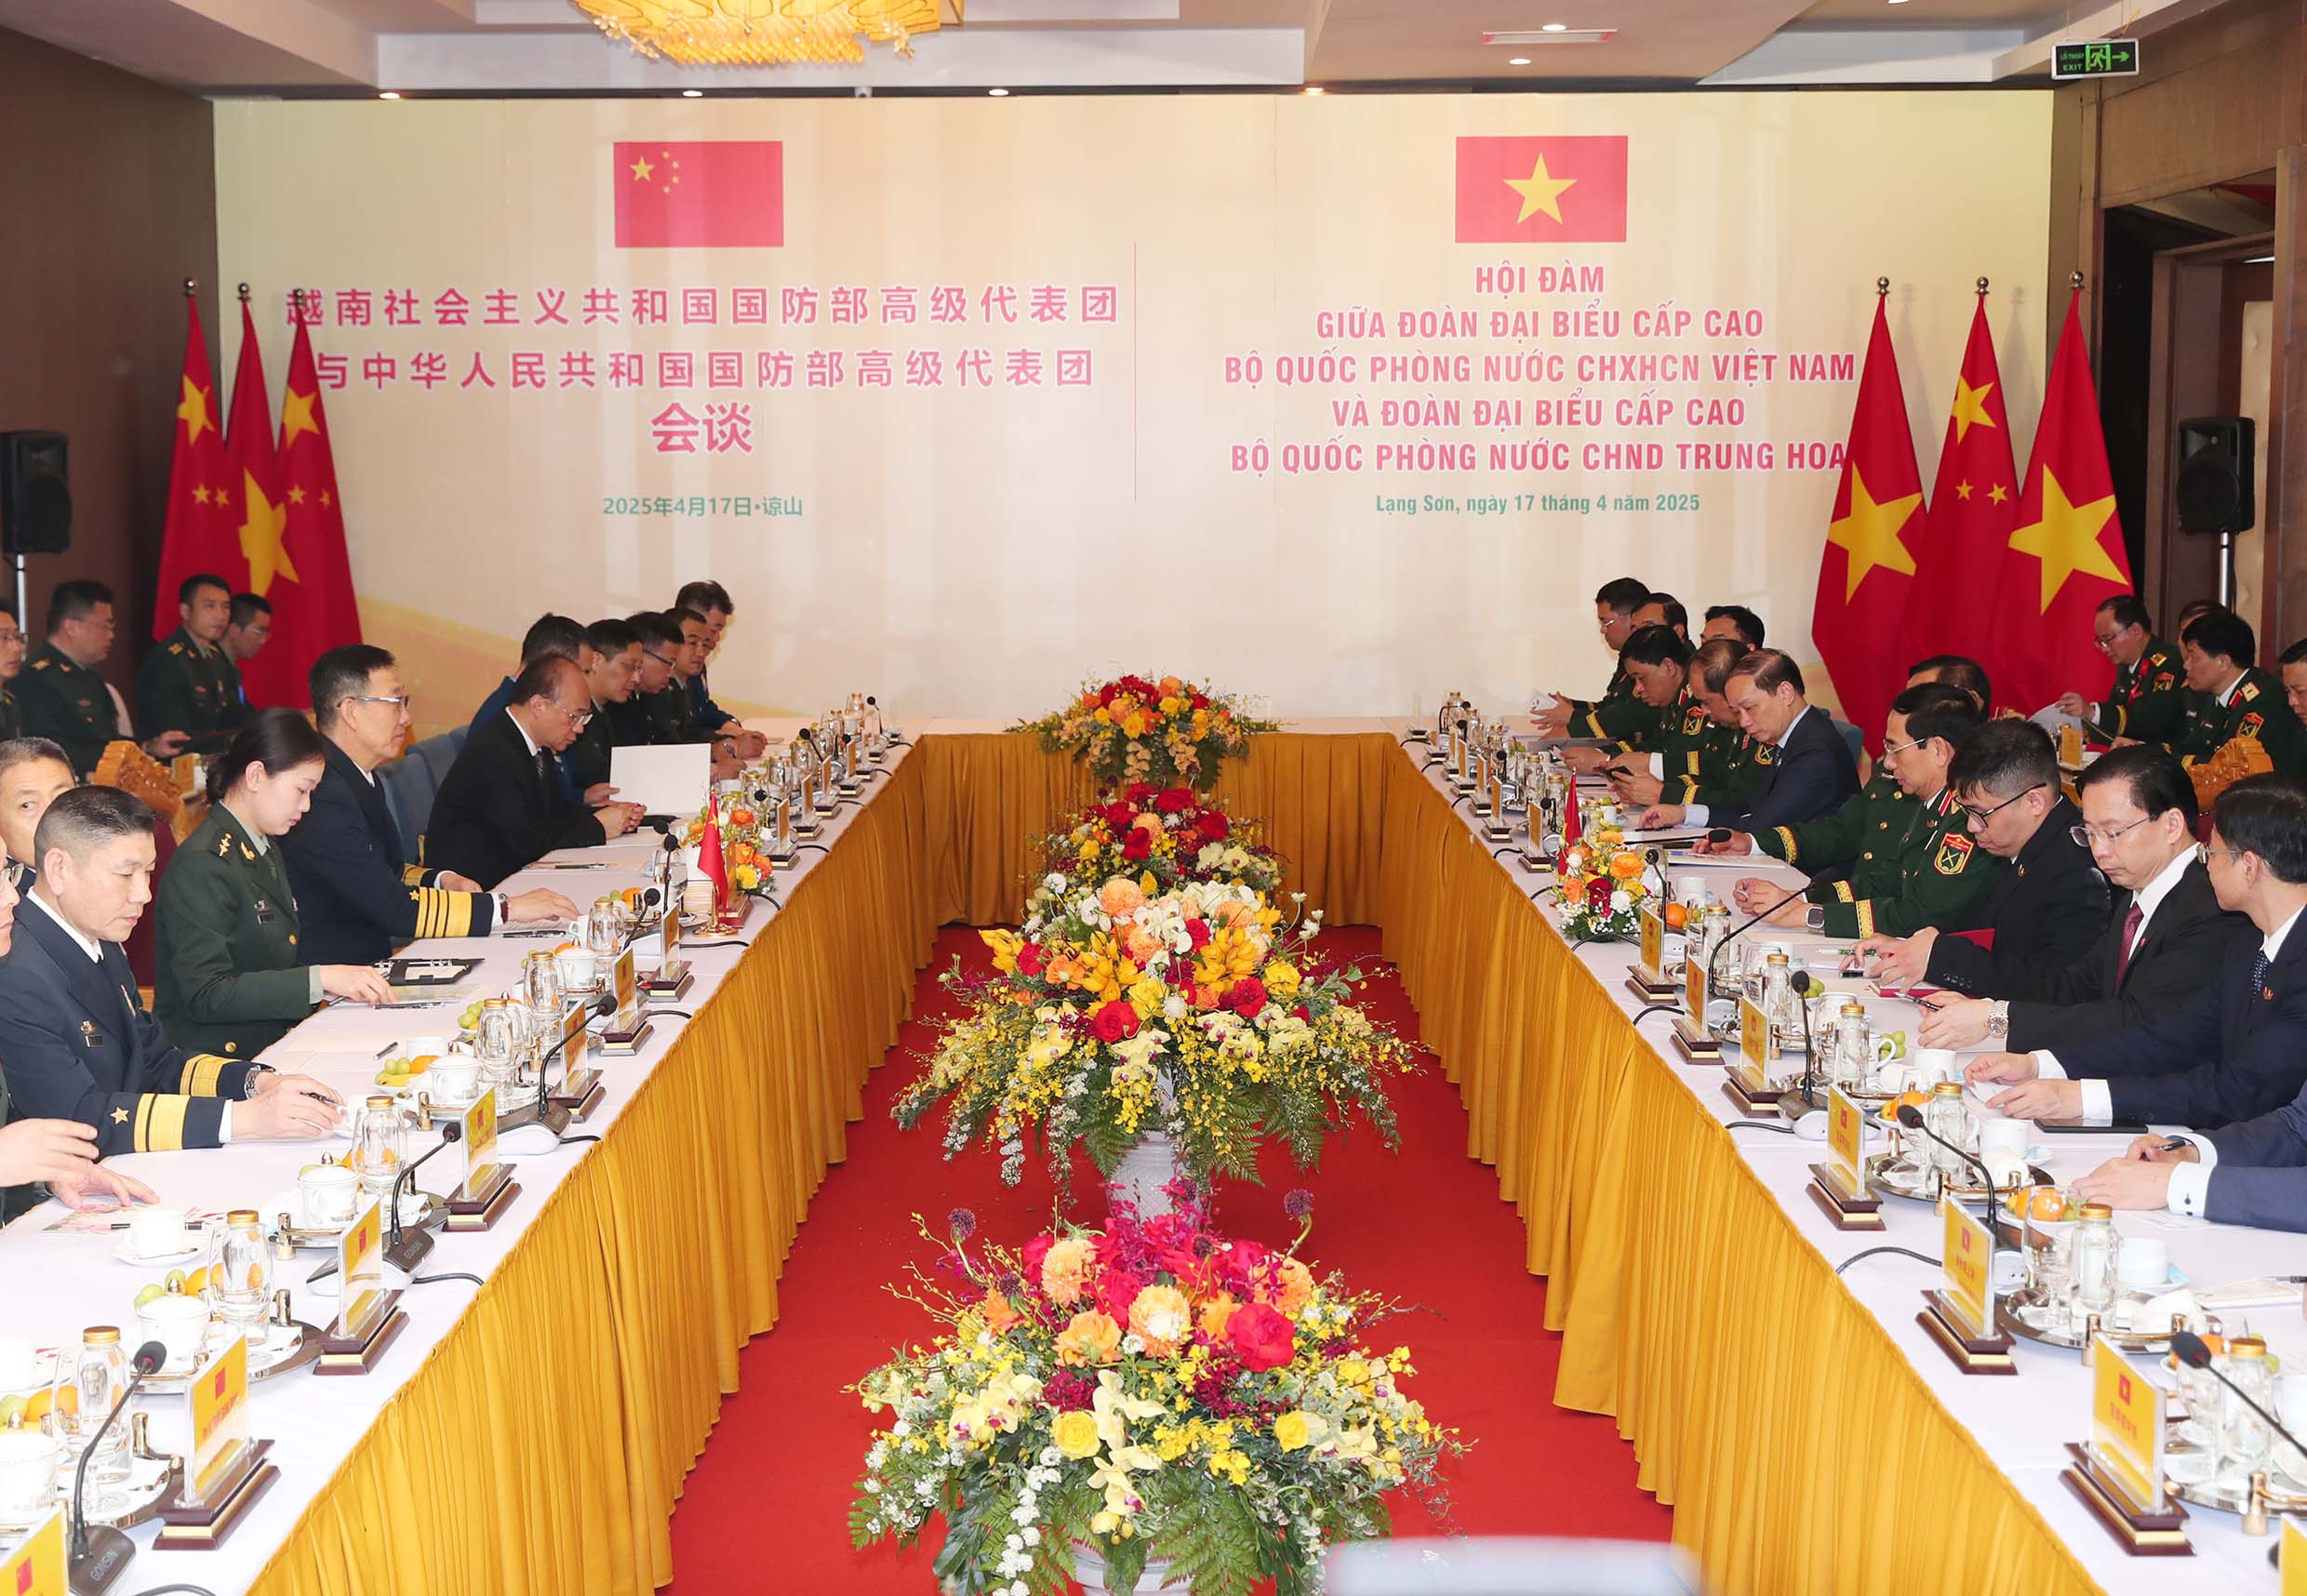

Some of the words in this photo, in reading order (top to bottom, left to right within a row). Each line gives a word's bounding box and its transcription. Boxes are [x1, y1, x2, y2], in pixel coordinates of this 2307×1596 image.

[2062, 63, 2083, 72] EXIT
[1475, 260, 1526, 299] HỘI
[1539, 258, 1605, 294] ĐÀM
[287, 285, 1118, 327] 越南社会主义共和国国防部高级代表团
[1317, 302, 1385, 339] GIỮA
[1398, 303, 1477, 339] ĐOÀN
[1490, 312, 1540, 344] ĐẠI
[1553, 299, 1620, 338] BIỂU
[1633, 300, 1692, 338] CẤP
[1704, 309, 1764, 338] CAO
[316, 349, 1092, 391] 与中华人民共和国国防部高级代表团
[1225, 350, 1263, 389] BỘ
[1275, 346, 1356, 385] QUỐC
[1370, 348, 1471, 384] PHÒNG
[1484, 347, 1565, 383] NƯỚC
[1577, 354, 1700, 382] CHXHCN
[1712, 348, 1778, 387] VIỆT
[1789, 353, 1854, 381] NAM
[650, 402, 753, 454] 会谈
[1332, 392, 1370, 427] VÀ
[1381, 392, 1460, 427] ĐOÀN
[1473, 400, 1522, 433] ĐẠI
[1535, 388, 1603, 427] BIỂU
[1615, 390, 1674, 427] CẤP
[1686, 397, 1745, 427] CAO
[1232, 438, 1270, 478] BỘ
[1282, 434, 1363, 473] QUỐC
[1376, 436, 1476, 472] PHÒNG
[1489, 436, 1570, 472] NƯỚC
[1582, 443, 1664, 472] CHND
[1675, 442, 1775, 471] TRUNG
[1786, 442, 1846, 471] HOA
[1376, 495, 1418, 515] Lạng
[1423, 495, 1460, 513] Sơn,
[1466, 495, 1508, 516] ngày
[1515, 495, 1535, 512] 17
[1540, 494, 1591, 515] tháng
[1596, 495, 1608, 512] 4
[1613, 494, 1650, 512] năm
[1656, 494, 1700, 512] 2025
